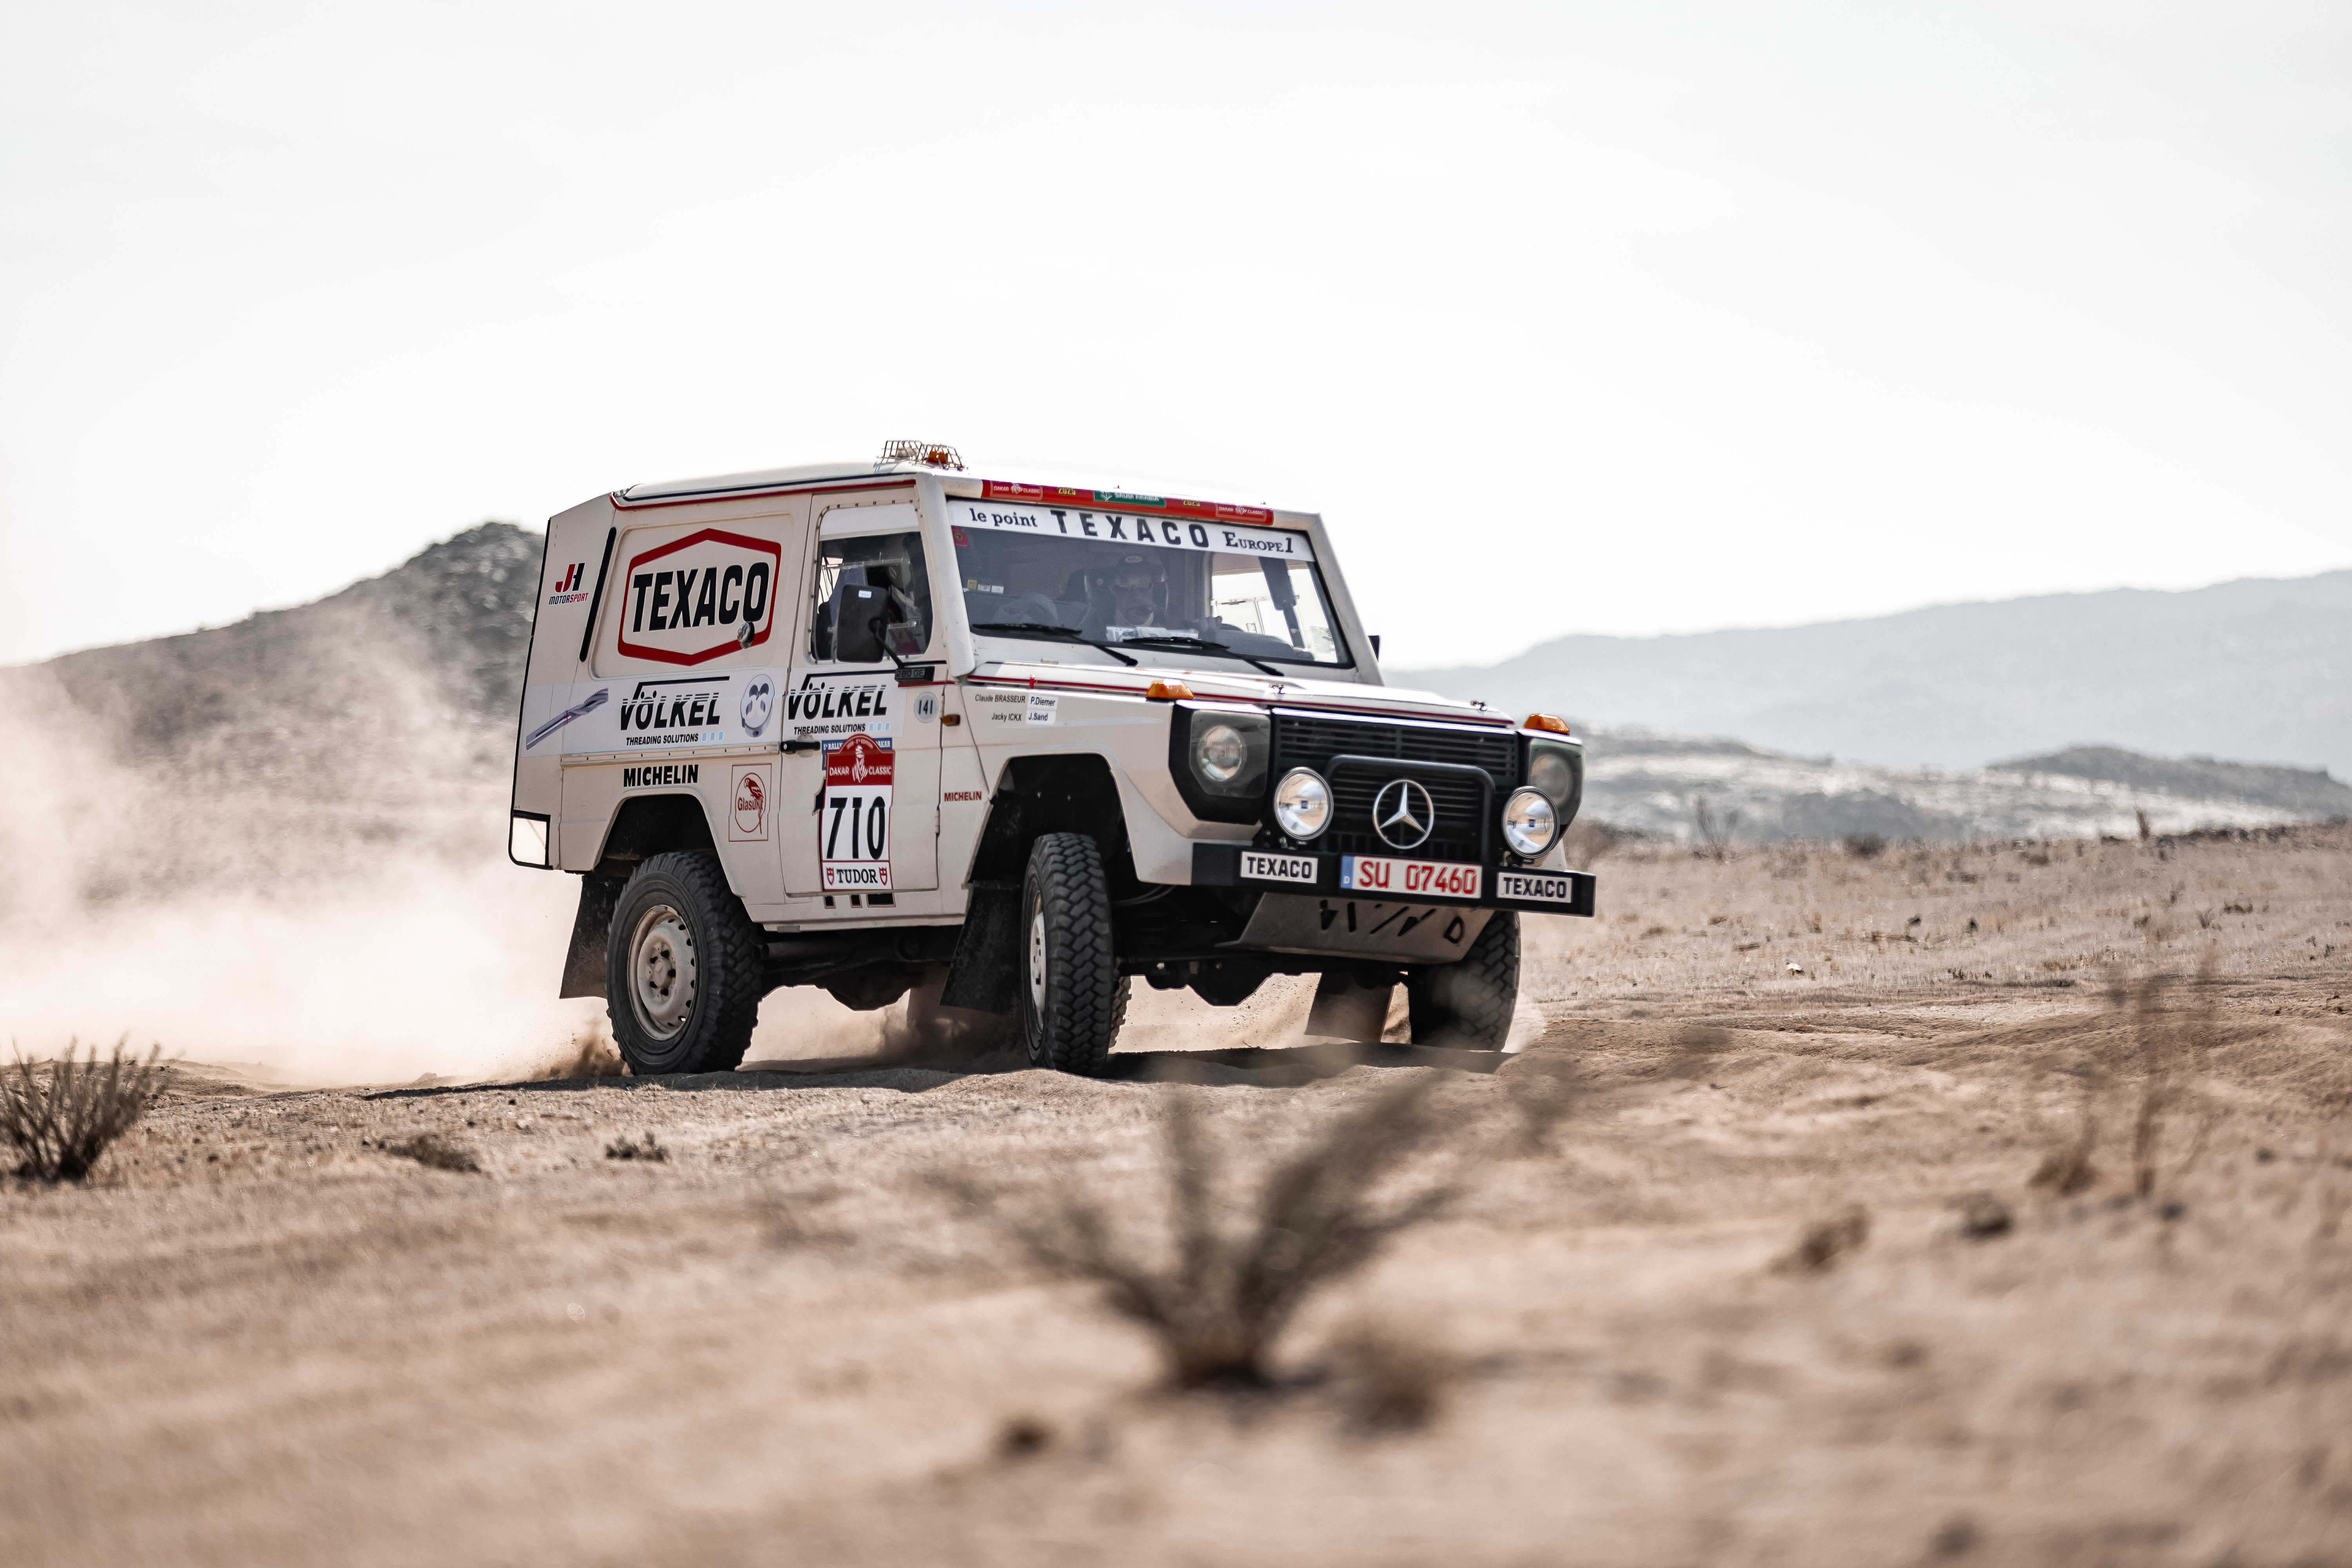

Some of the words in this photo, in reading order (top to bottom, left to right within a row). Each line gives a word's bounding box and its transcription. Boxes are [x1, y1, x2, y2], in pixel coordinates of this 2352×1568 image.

[969, 508, 987, 522] le
[992, 512, 1038, 527] point
[1050, 509, 1209, 548] TEXACO
[555, 562, 585, 593] JH
[548, 592, 589, 605] MOTORSPORT
[632, 562, 769, 633] TEXACO
[788, 682, 887, 720] VÖLKEL
[975, 694, 993, 702] Claude
[995, 695, 1025, 703] BRASSEUR
[1030, 696, 1056, 706] P.Diemer
[621, 690, 720, 731] VÖLKEL
[991, 712, 1007, 722] Jacky
[1008, 713, 1022, 721] ICKX
[1028, 712, 1049, 721] J.Sand
[794, 725, 829, 735] THREADING
[831, 723, 866, 733] SOLUTIONS
[626, 735, 661, 746] THREADING
[663, 733, 699, 744] SOLUTIONS
[623, 764, 699, 788] MICHELIN
[829, 766, 849, 776] DAKAR
[868, 765, 892, 776] CLASSIC
[944, 791, 982, 802] MICHELIN
[826, 796, 886, 860] 710
[836, 868, 878, 884] TUDOR
[1247, 856, 1312, 879] TEXACO
[1359, 860, 1390, 889] SU
[1405, 864, 1477, 895] 07460
[1503, 877, 1567, 898] TEXACO
